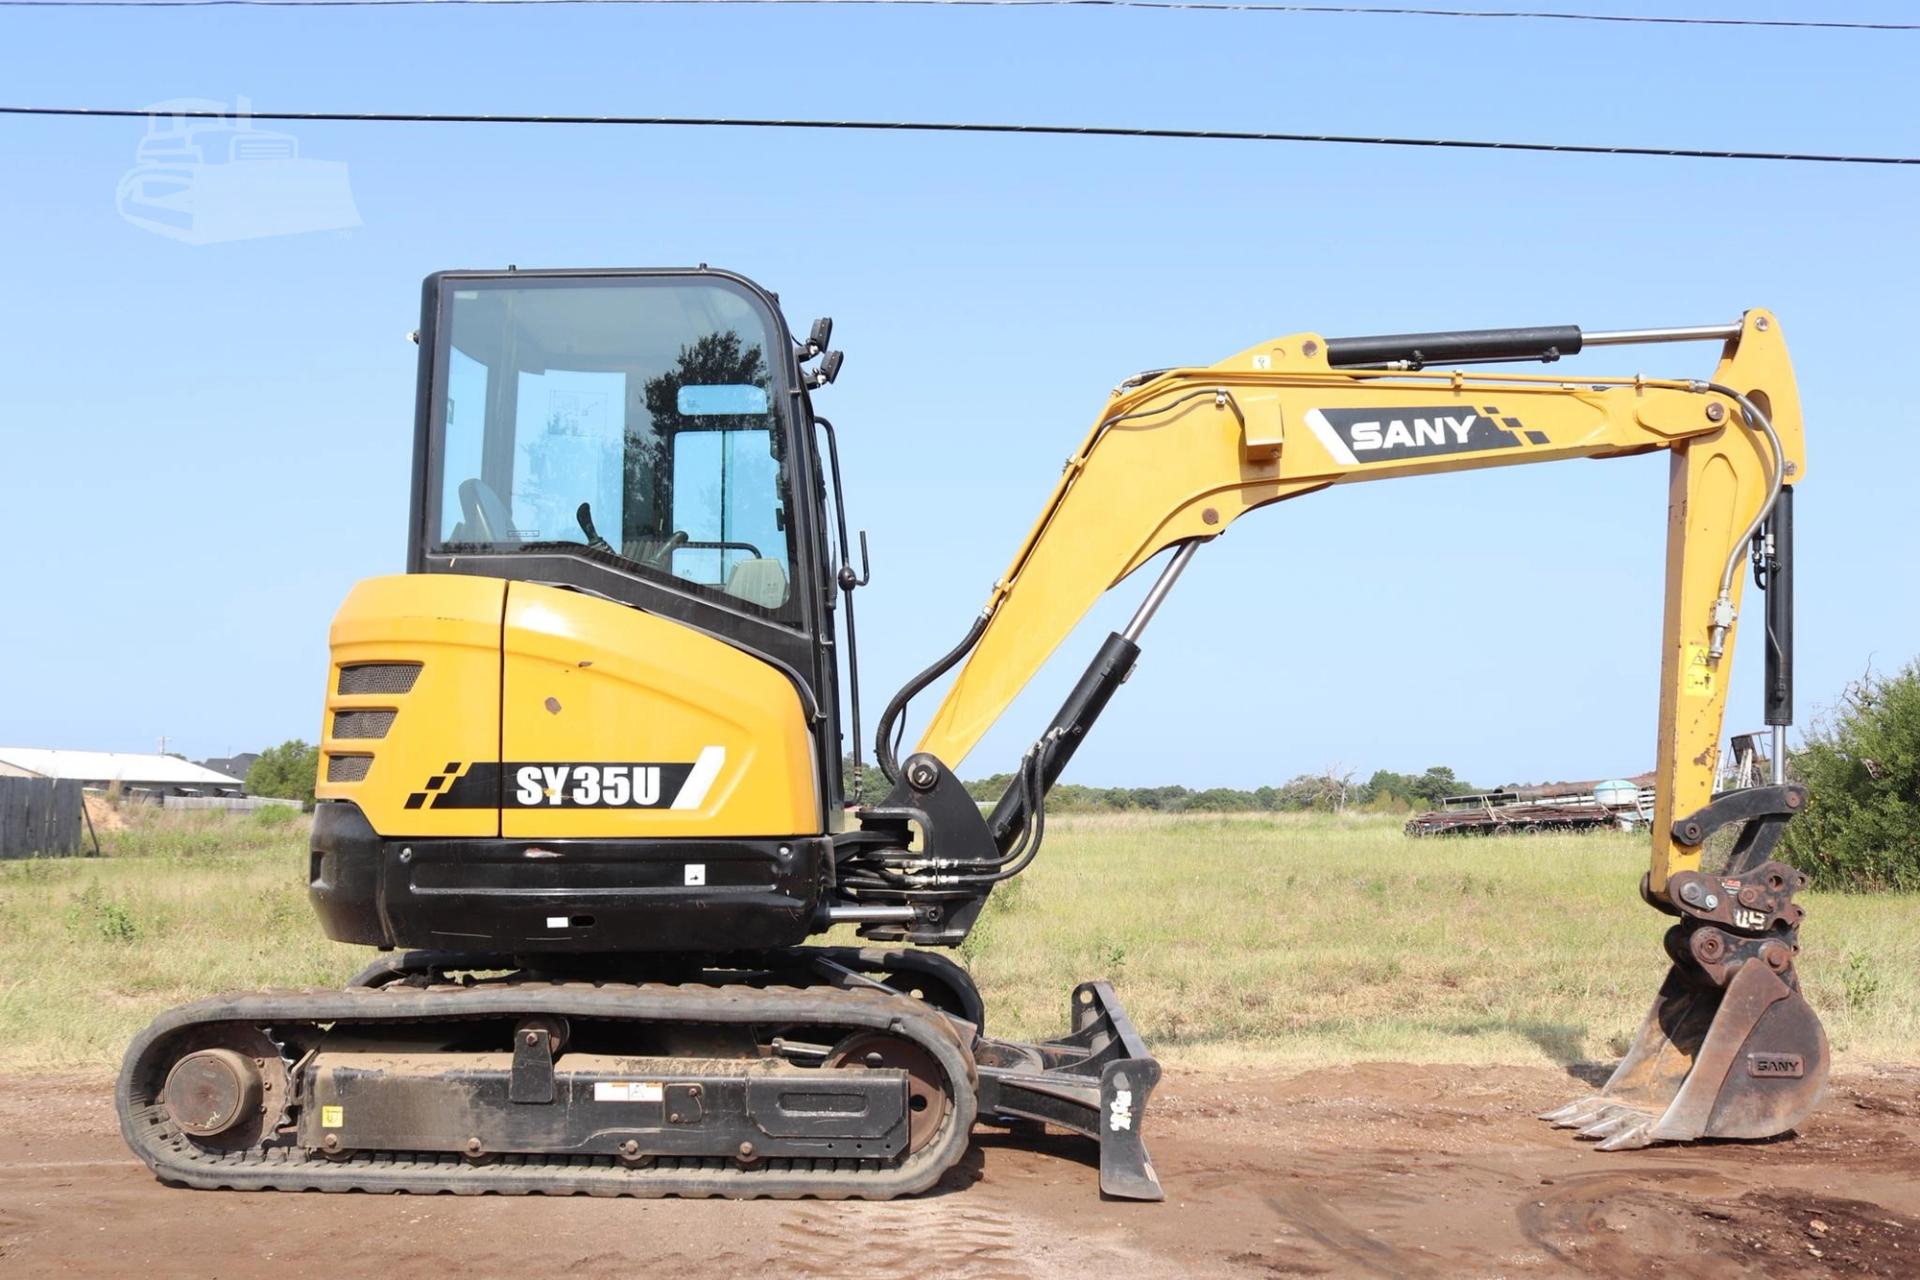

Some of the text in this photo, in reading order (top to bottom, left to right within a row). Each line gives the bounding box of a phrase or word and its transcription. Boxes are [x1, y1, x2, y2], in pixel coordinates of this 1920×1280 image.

[1350, 415, 1477, 450] SANY
[516, 766, 661, 805] SY35U
[1757, 1060, 1799, 1072] SANY
